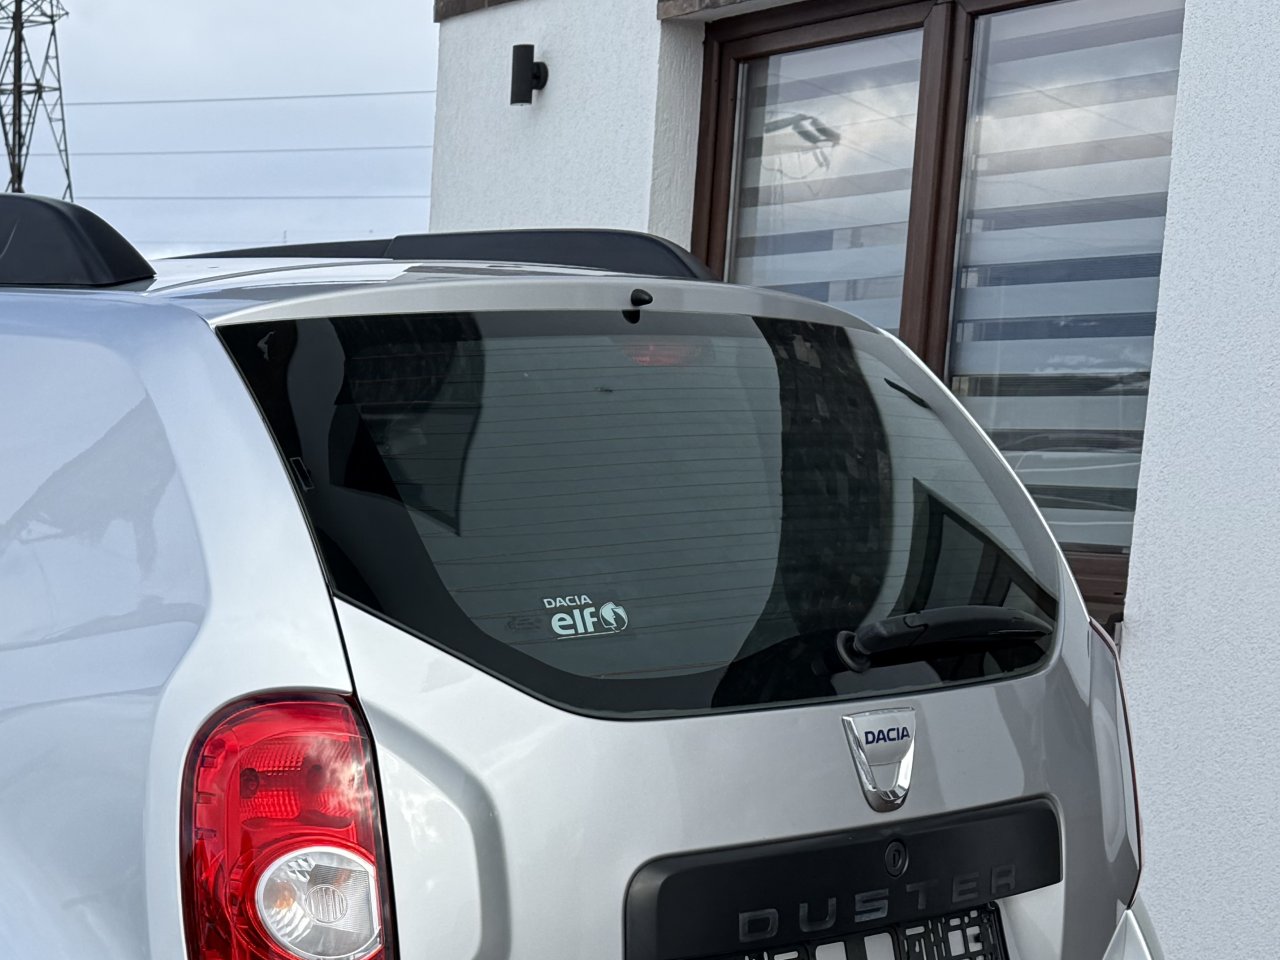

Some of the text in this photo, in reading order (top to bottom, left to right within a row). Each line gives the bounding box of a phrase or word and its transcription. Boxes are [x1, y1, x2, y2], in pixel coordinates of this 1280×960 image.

[543, 595, 592, 608] DACIA
[551, 607, 598, 635] elf
[864, 726, 911, 745] DACIA
[738, 863, 1017, 943] DUSTER
